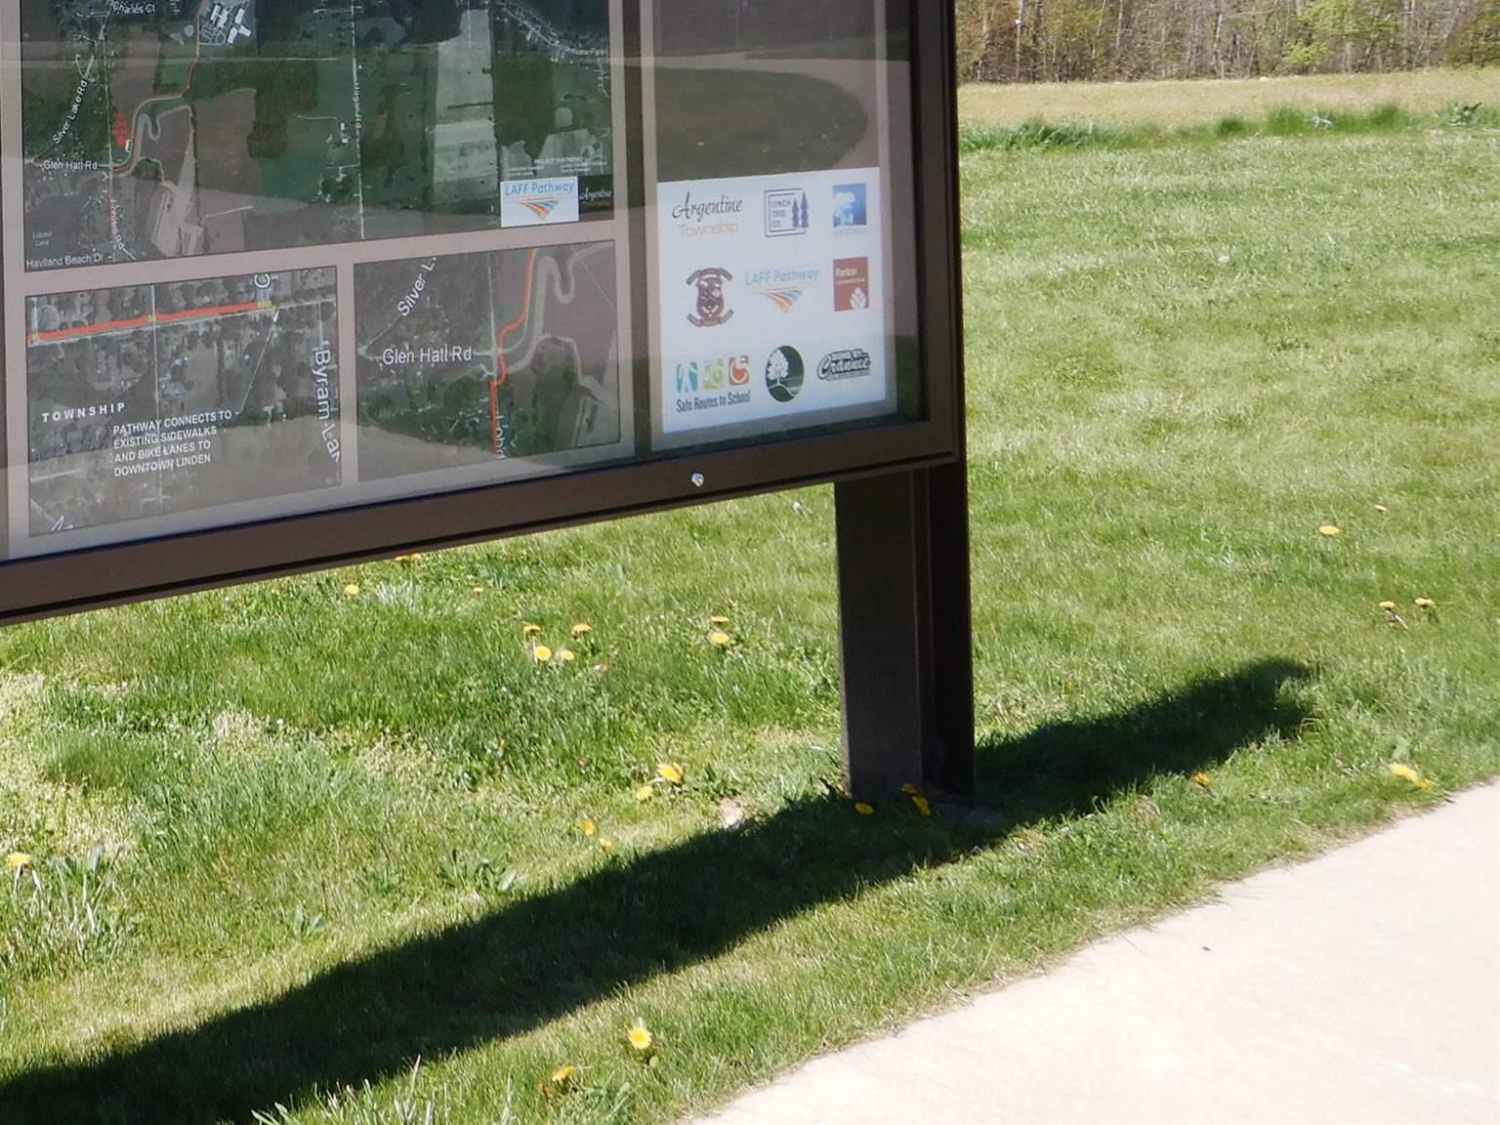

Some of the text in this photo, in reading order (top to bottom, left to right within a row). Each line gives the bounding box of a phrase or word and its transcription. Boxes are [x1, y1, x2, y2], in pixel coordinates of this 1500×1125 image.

[672, 191, 743, 223] Argentine
[398, 274, 426, 317] Silver
[382, 348, 415, 365] Glen
[452, 346, 472, 362] Rd
[312, 350, 331, 420] Byram
[42, 402, 125, 423] TOWNSHIP
[113, 410, 232, 436] PATHWAY CONNECTS TO
[113, 425, 218, 450] EXISTING SIDEWALKS
[114, 440, 211, 463] AND BIKE LANES TO
[114, 453, 211, 477] DOWNTOWN LINDEN
